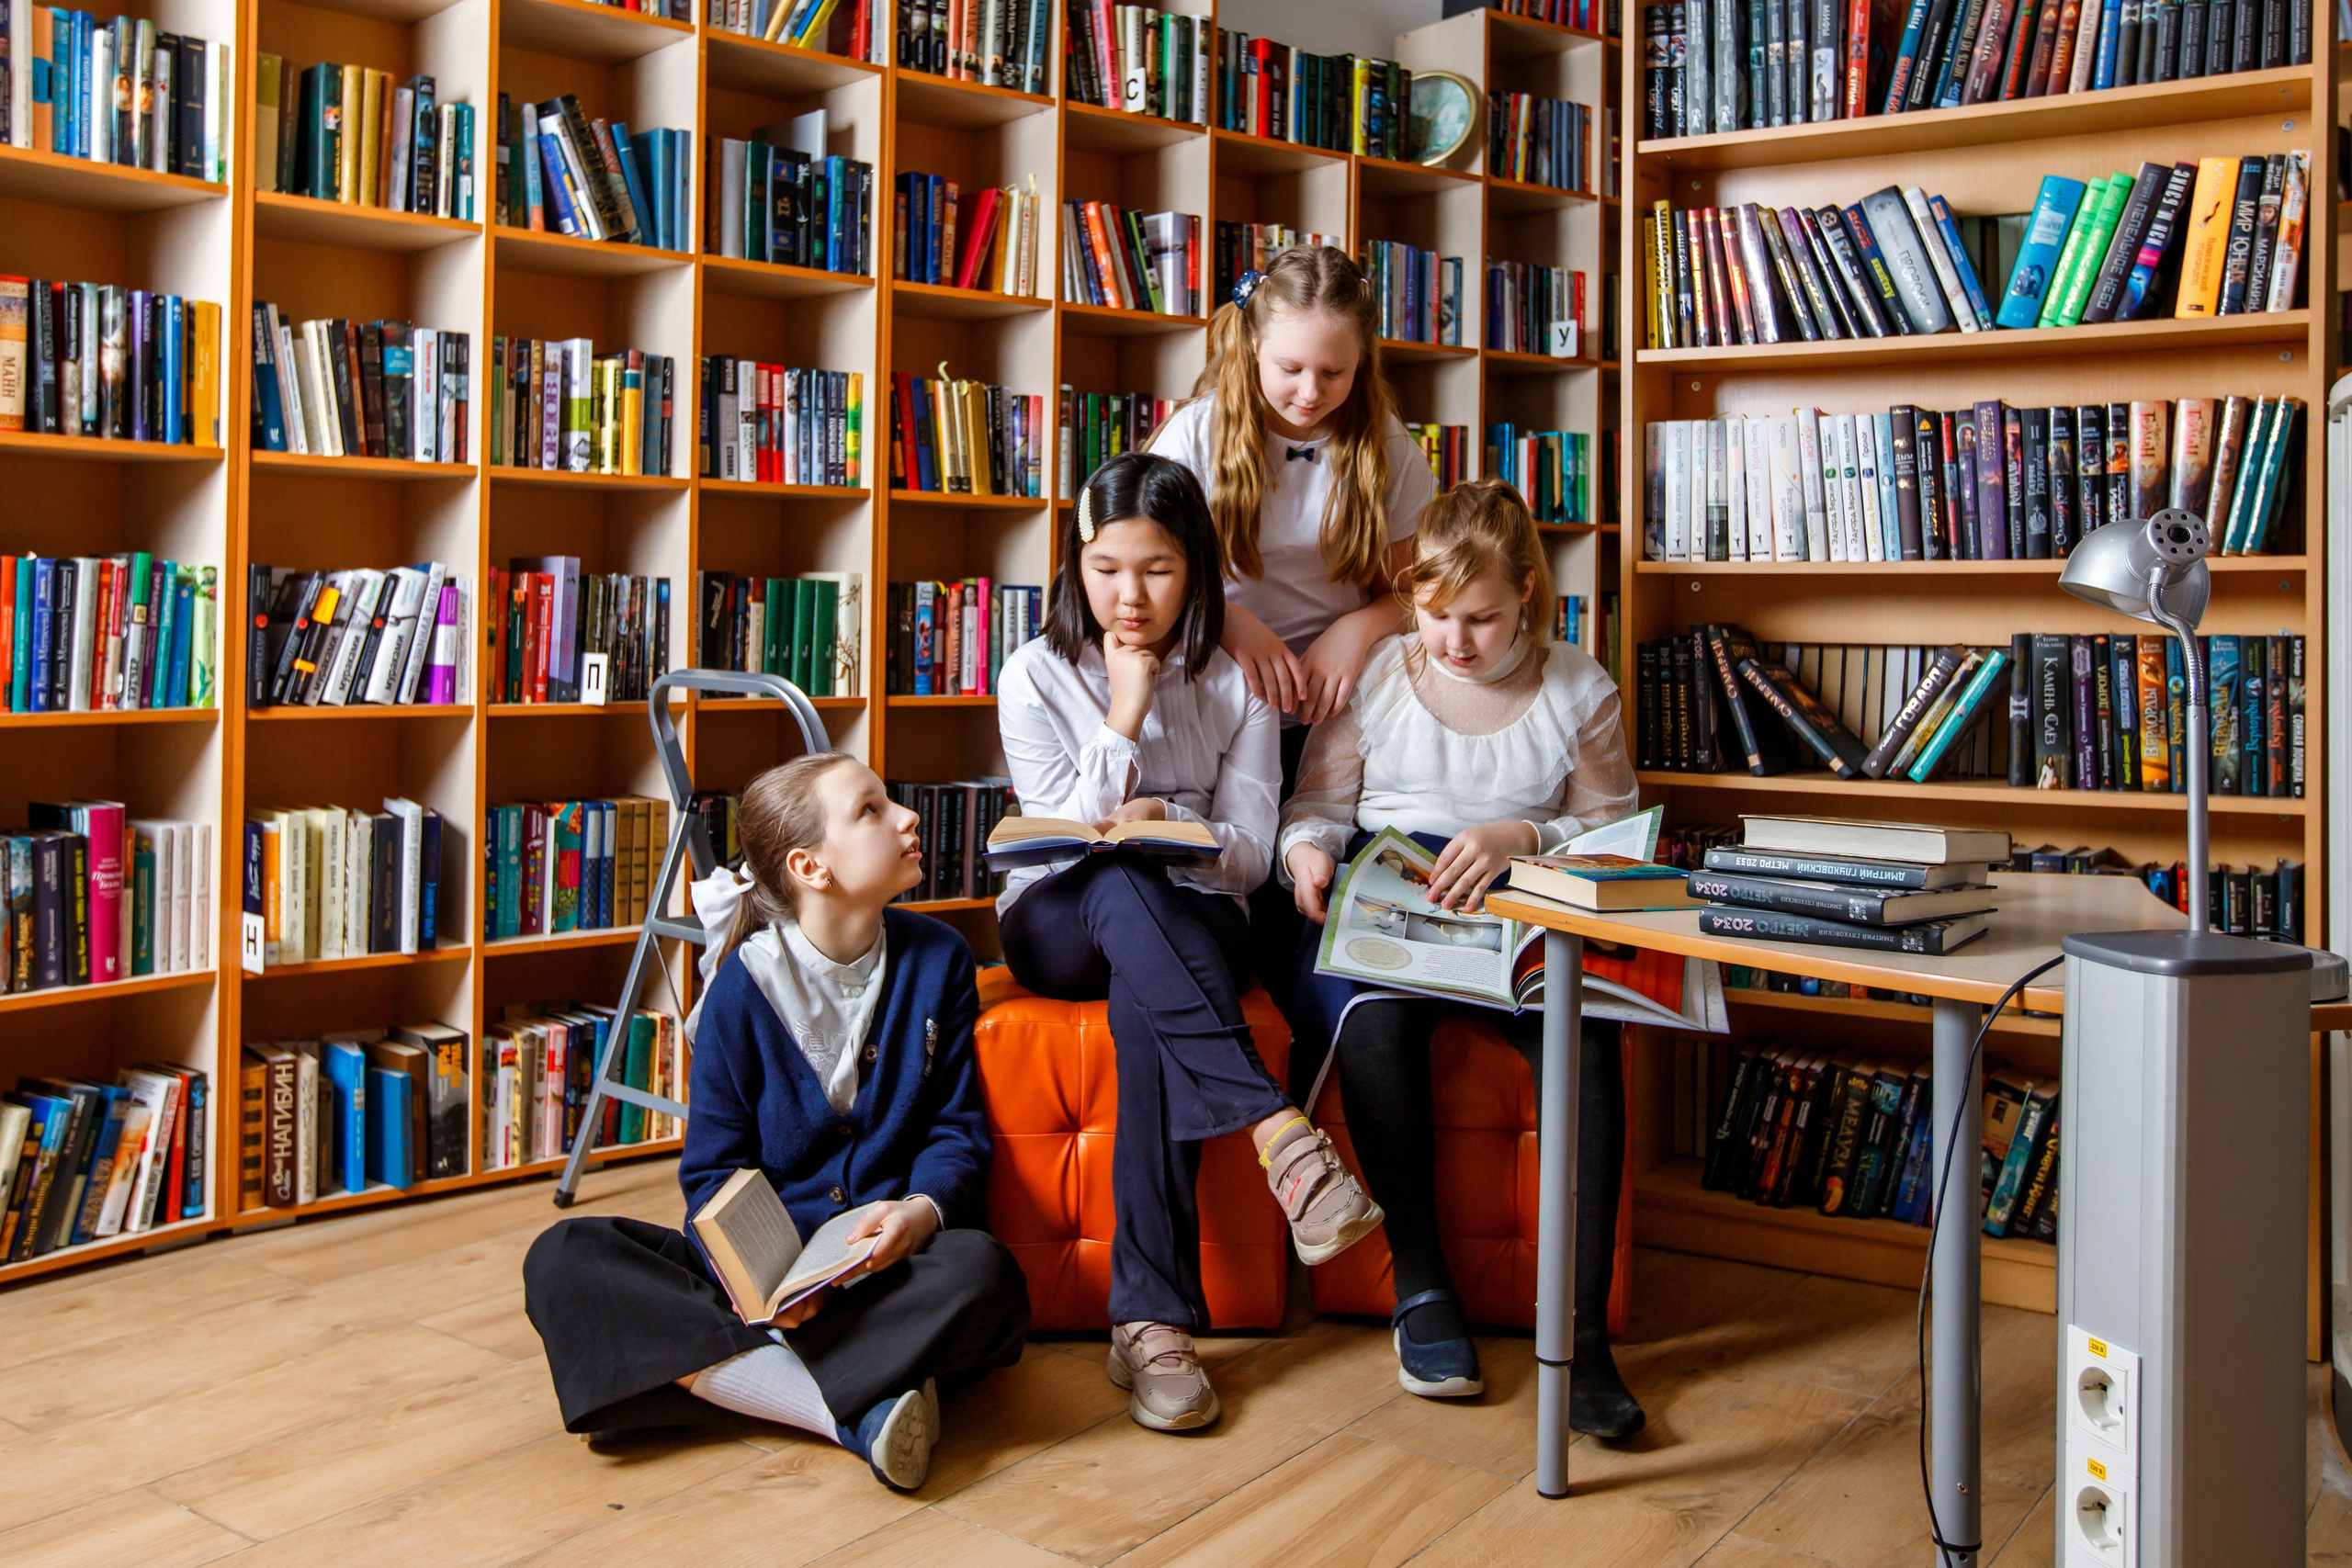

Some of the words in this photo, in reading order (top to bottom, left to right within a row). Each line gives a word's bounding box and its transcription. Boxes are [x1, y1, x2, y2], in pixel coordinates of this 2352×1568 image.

[1960, 41, 1971, 51] ИЗ
[1889, 56, 1911, 96] БУЛЫЧЕВ
[1952, 54, 1969, 78] МЕСТЬ
[1126, 77, 1139, 100] С
[1655, 69, 1664, 129] АНДЕРСОН
[1678, 68, 1686, 128] АНДЕРСОН
[2162, 169, 2190, 206] БЭНКС
[2273, 164, 2283, 188] ЭНДИ
[2155, 208, 2174, 220] М.
[2236, 200, 2256, 231] МИР
[1654, 208, 1668, 288] САДОВНИК
[2110, 204, 2149, 275] ПЕПЕЛЬНОЕ
[2145, 224, 2169, 246] ИЭН
[1678, 230, 1687, 277] ИЩЕЙКА
[2229, 236, 2249, 284] ЮНЫХ
[2248, 238, 2268, 310] МАРСИАНИН
[2096, 277, 2119, 310] НЕБО
[2, 356, 17, 399] МАНН
[544, 380, 559, 467] ОРЛОВ
[1847, 481, 1855, 511] Веркин
[1869, 513, 1877, 545] Эдуард
[39, 612, 51, 660] Матвеева
[57, 612, 70, 660] Матвеева
[1694, 632, 1703, 659] 2034
[37, 662, 48, 690] Анна
[56, 662, 67, 690] Анна
[312, 635, 339, 692] мураками
[338, 635, 361, 691] мураками
[384, 635, 404, 691] мураками
[587, 663, 601, 691] П
[1711, 638, 1737, 699] СУМЕРКИ
[1744, 668, 1792, 717] СУМЕРКИ
[1895, 667, 1946, 731] ГОВАРД
[2098, 665, 2109, 708] ДОРОГА
[2169, 697, 2185, 745] Верлорды
[2245, 698, 2262, 752] Верлорды
[2267, 699, 2285, 750] Верлорды
[2292, 714, 2303, 746] СОННАЯ
[2290, 746, 2303, 783] ЛОЩИНА
[1736, 857, 1758, 867] 2033
[1759, 859, 1789, 870] МЕТРО
[1797, 863, 1857, 877] ГЛУХОВСКИЙ
[1860, 868, 1905, 881] ДМИТРИЙ
[1695, 881, 1728, 897] 2034
[1730, 886, 1773, 904] МЕТРО
[1781, 896, 1815, 907] ГЛУХОВСКИЙ
[1815, 901, 1842, 910] ДМИТРИЙ
[1713, 916, 1753, 931] 2034
[1756, 919, 1809, 937] МЕТРО
[1818, 929, 1860, 940] ГЛУХОВСКИЙ
[1862, 933, 1894, 942] ДМИТРИЙ
[246, 924, 256, 956] Н
[273, 1064, 294, 1157] НАГИБИН
[1830, 1100, 1862, 1169] МЕДУЗА
[29, 1179, 49, 1215] Миллер
[2089, 1462, 2098, 1472] 220
